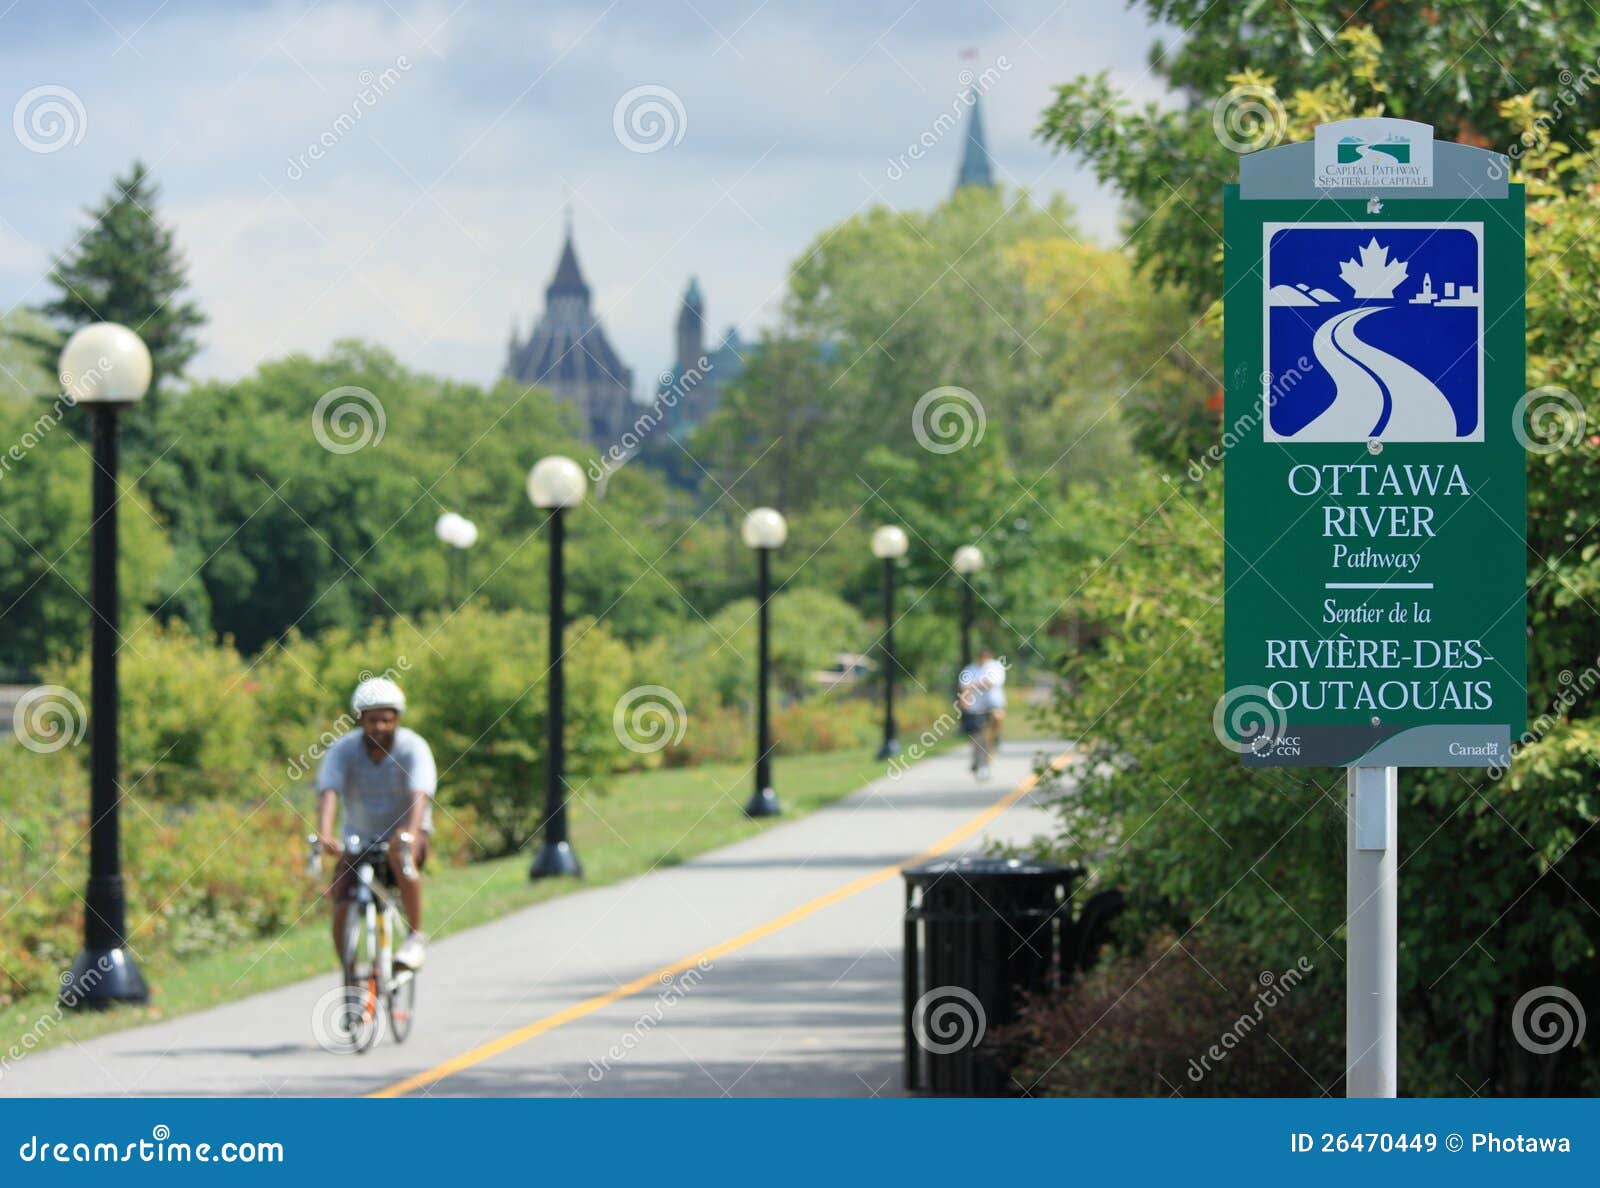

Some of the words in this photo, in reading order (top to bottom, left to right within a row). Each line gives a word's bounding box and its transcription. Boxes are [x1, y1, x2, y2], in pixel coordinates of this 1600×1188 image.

[1288, 464, 1471, 496] OTTAWA
[1322, 506, 1436, 537] RIVER
[1332, 544, 1421, 573] Pathway
[1323, 599, 1383, 623] Sentier
[1389, 602, 1408, 623] de
[1413, 602, 1432, 623] la
[1265, 633, 1494, 668] RIVIÈRE-DES-
[1267, 681, 1493, 710] OUTAOUAIS
[1276, 736, 1301, 746] NCC
[1276, 747, 1301, 756] CCN
[1448, 742, 1498, 756] Canada
